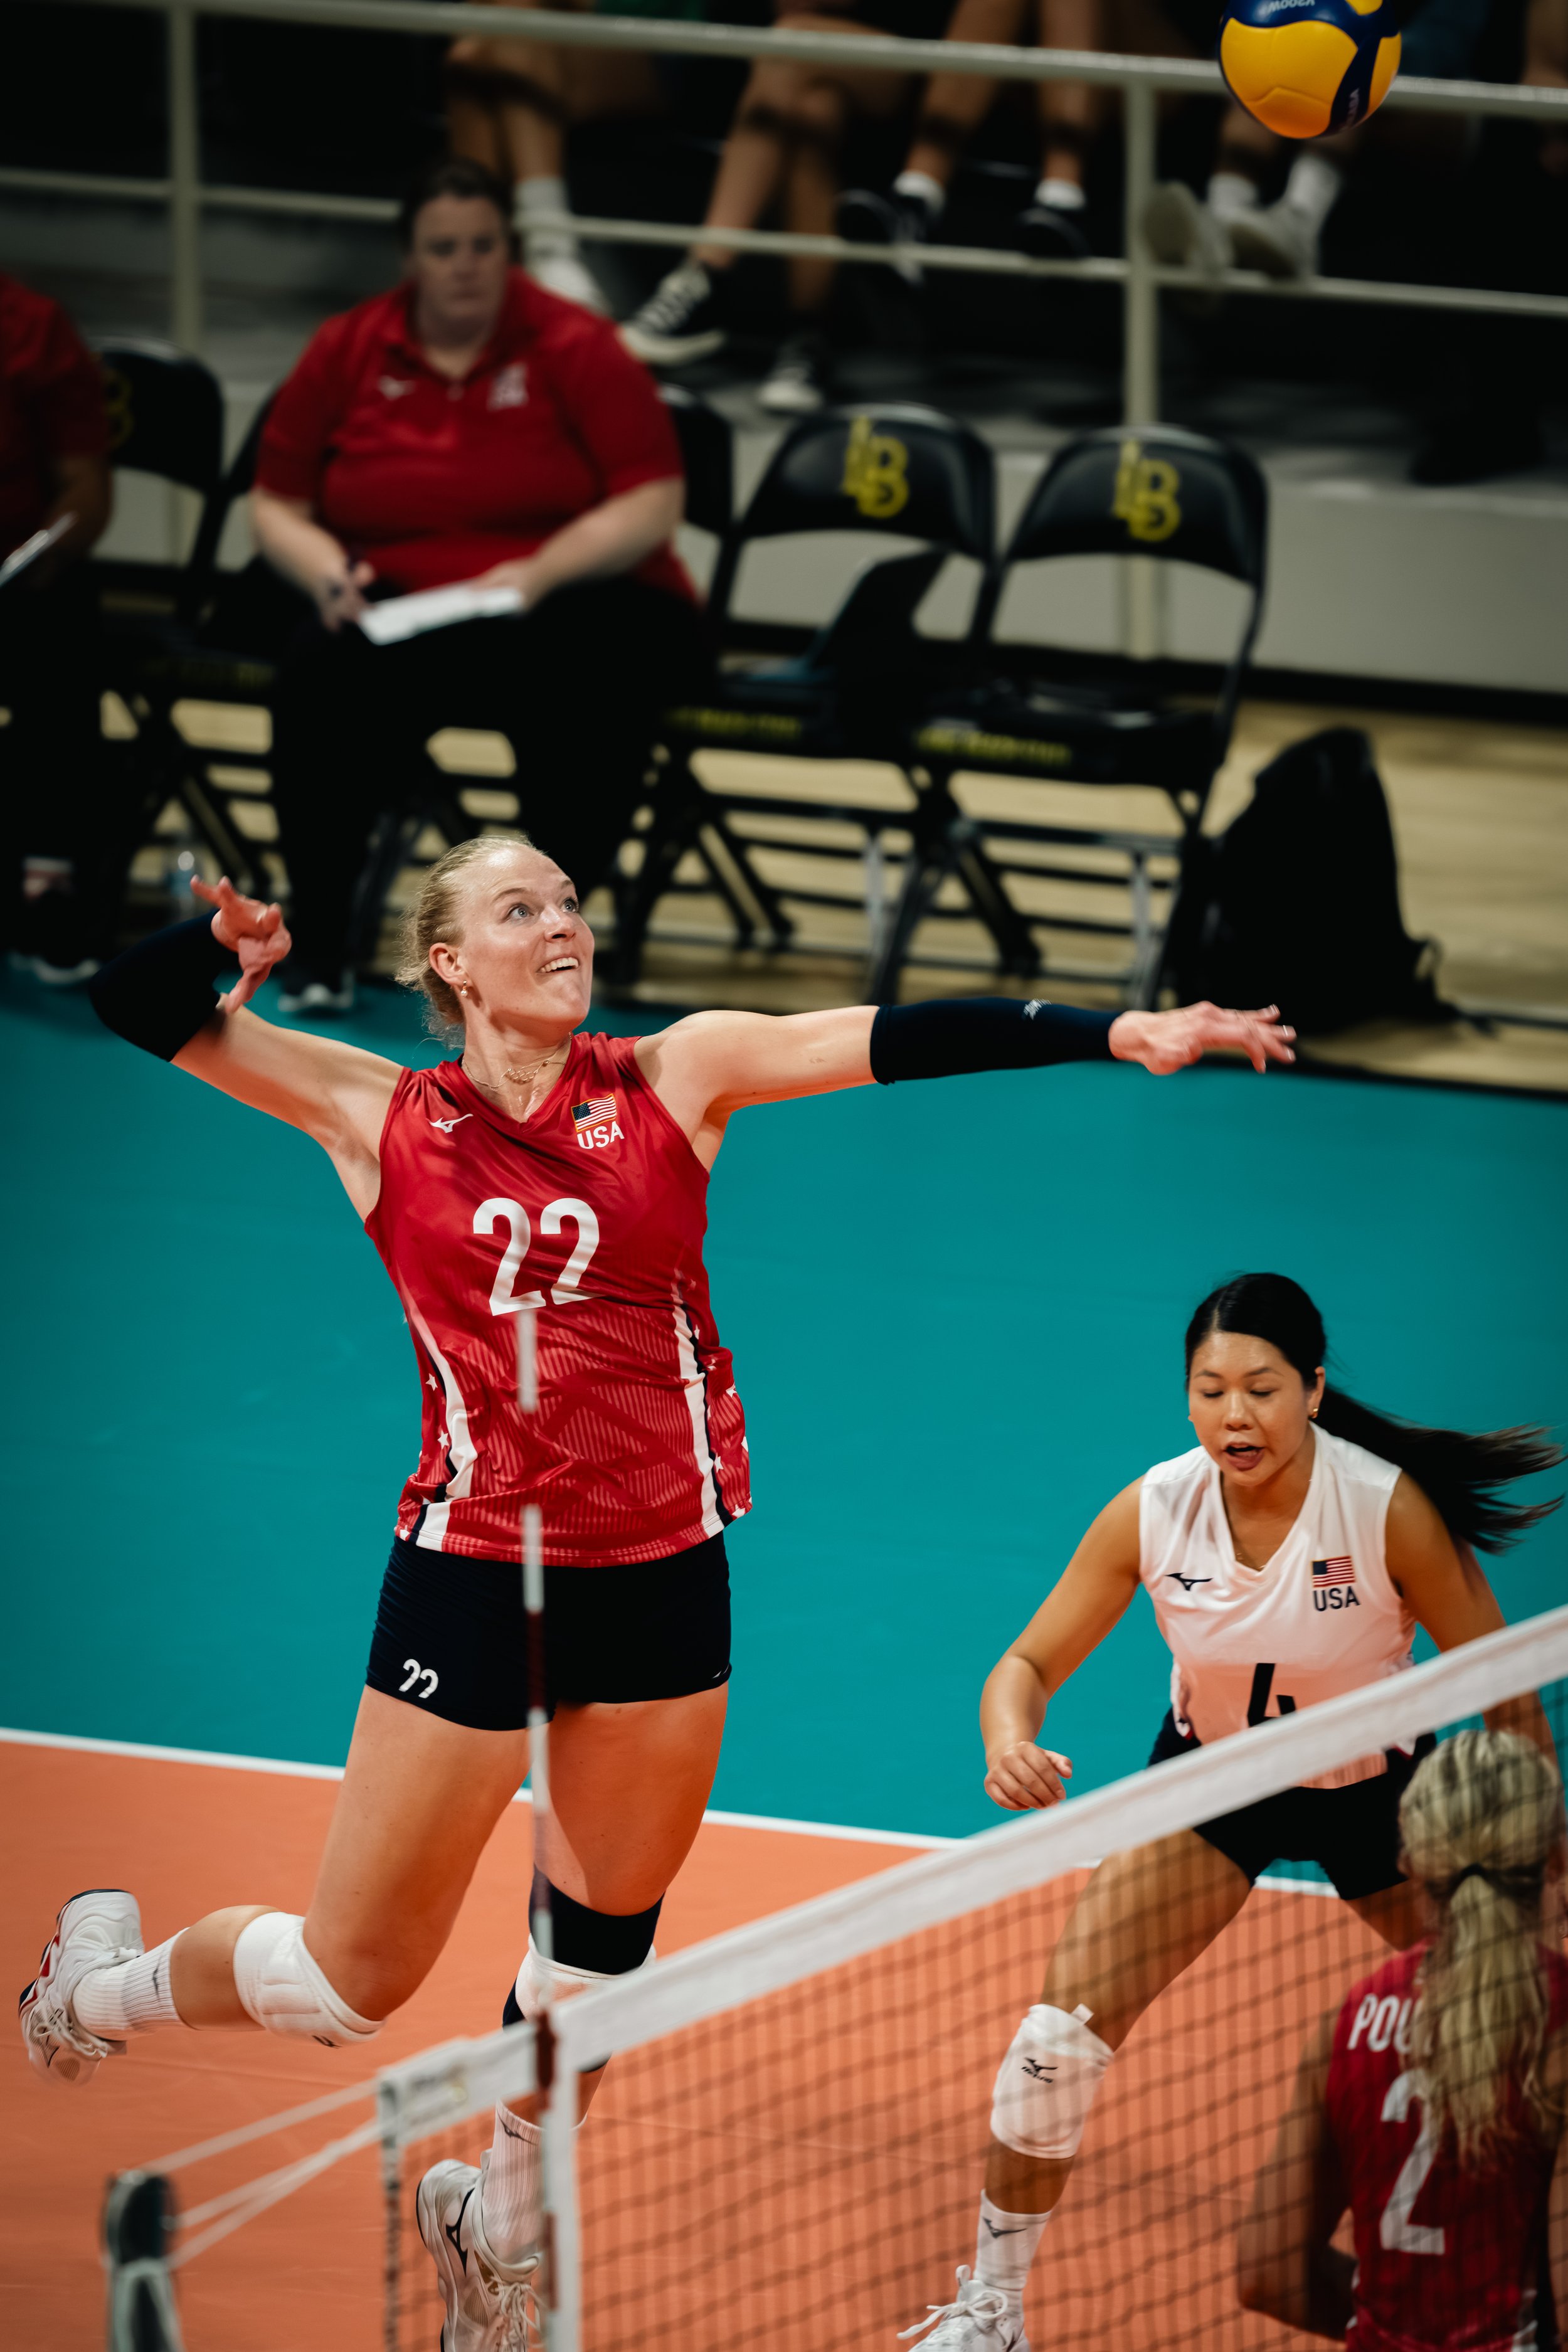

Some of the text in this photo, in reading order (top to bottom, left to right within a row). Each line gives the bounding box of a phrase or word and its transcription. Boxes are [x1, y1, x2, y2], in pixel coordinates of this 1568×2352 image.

[577, 1121, 625, 1149] USA
[473, 1197, 605, 1316] 22
[1313, 1586, 1360, 1611] USA
[399, 1659, 438, 1698] 22
[1247, 1663, 1296, 1728] 4
[1347, 1993, 1433, 2055] POU
[1380, 2069, 1445, 2255] 2
